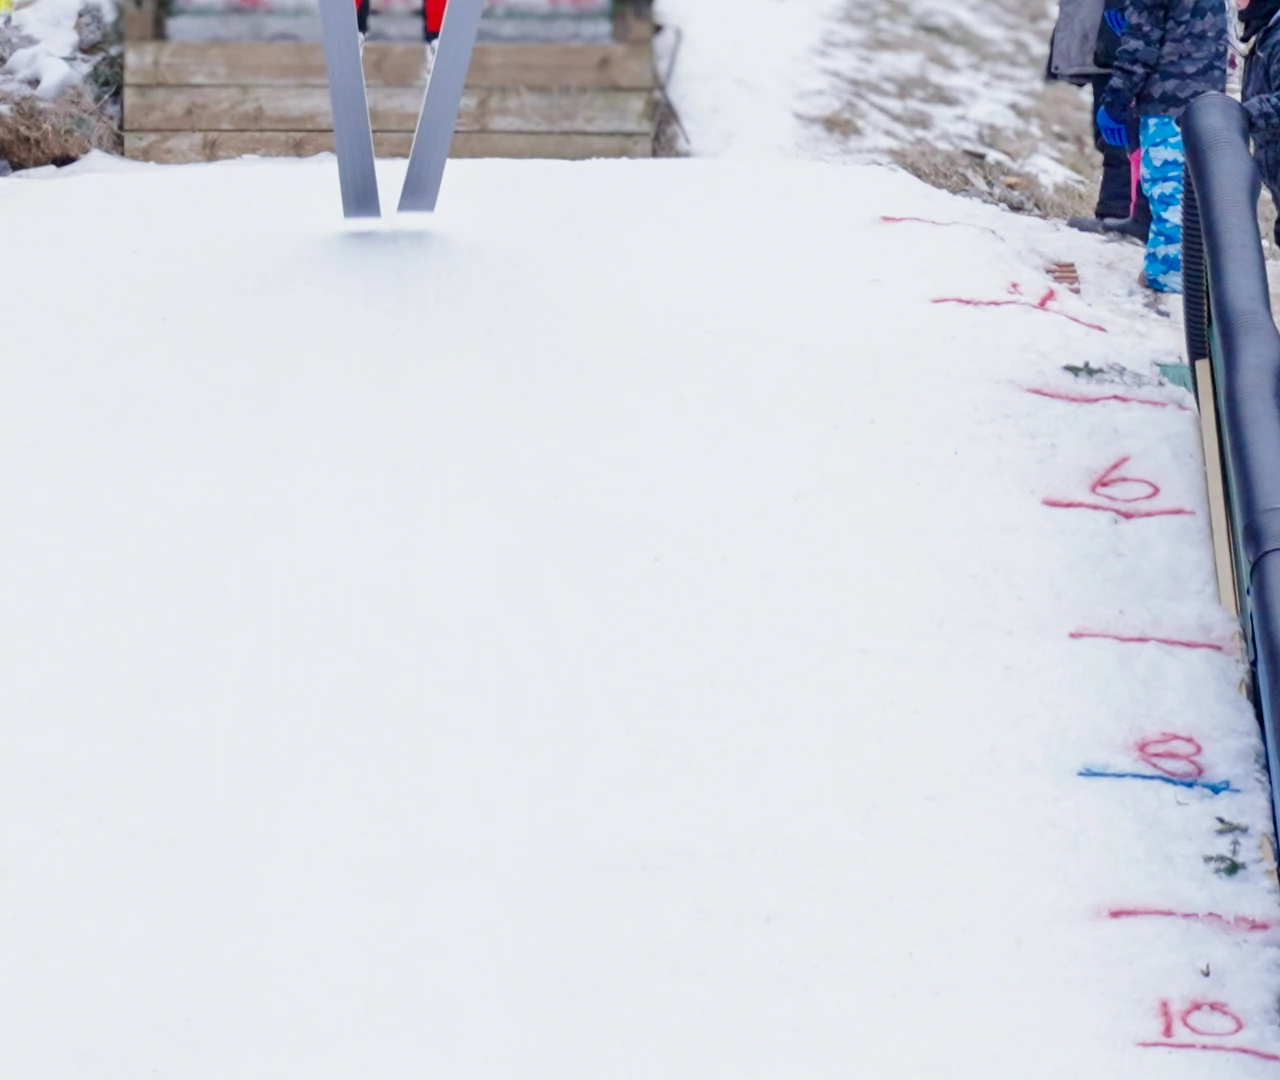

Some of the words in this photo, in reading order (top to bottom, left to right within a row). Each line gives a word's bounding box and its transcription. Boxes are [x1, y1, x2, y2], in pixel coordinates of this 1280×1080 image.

[1090, 455, 1160, 502] 6
[1137, 731, 1204, 778] 8
[1160, 999, 1244, 1038] 10
